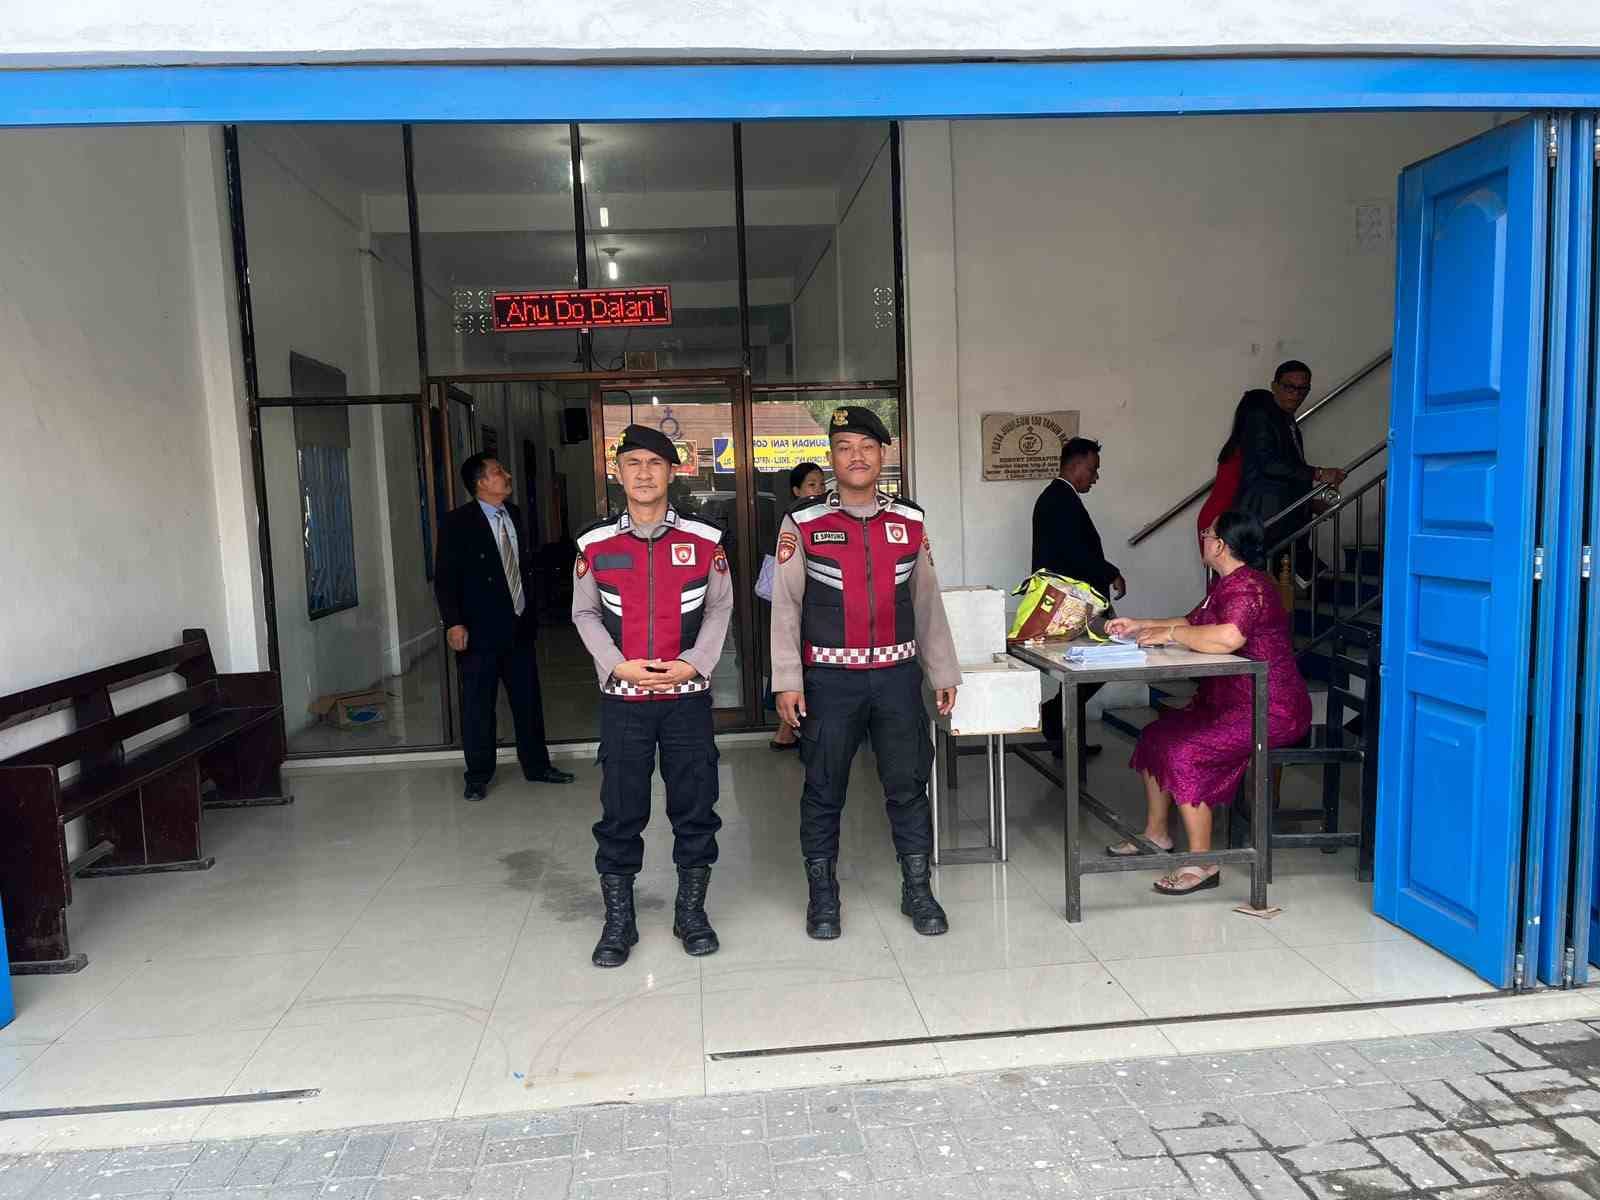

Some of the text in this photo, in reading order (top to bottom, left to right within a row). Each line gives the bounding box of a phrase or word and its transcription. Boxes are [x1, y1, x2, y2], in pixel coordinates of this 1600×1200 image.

[507, 297, 655, 322] Ahu Do Dalani
